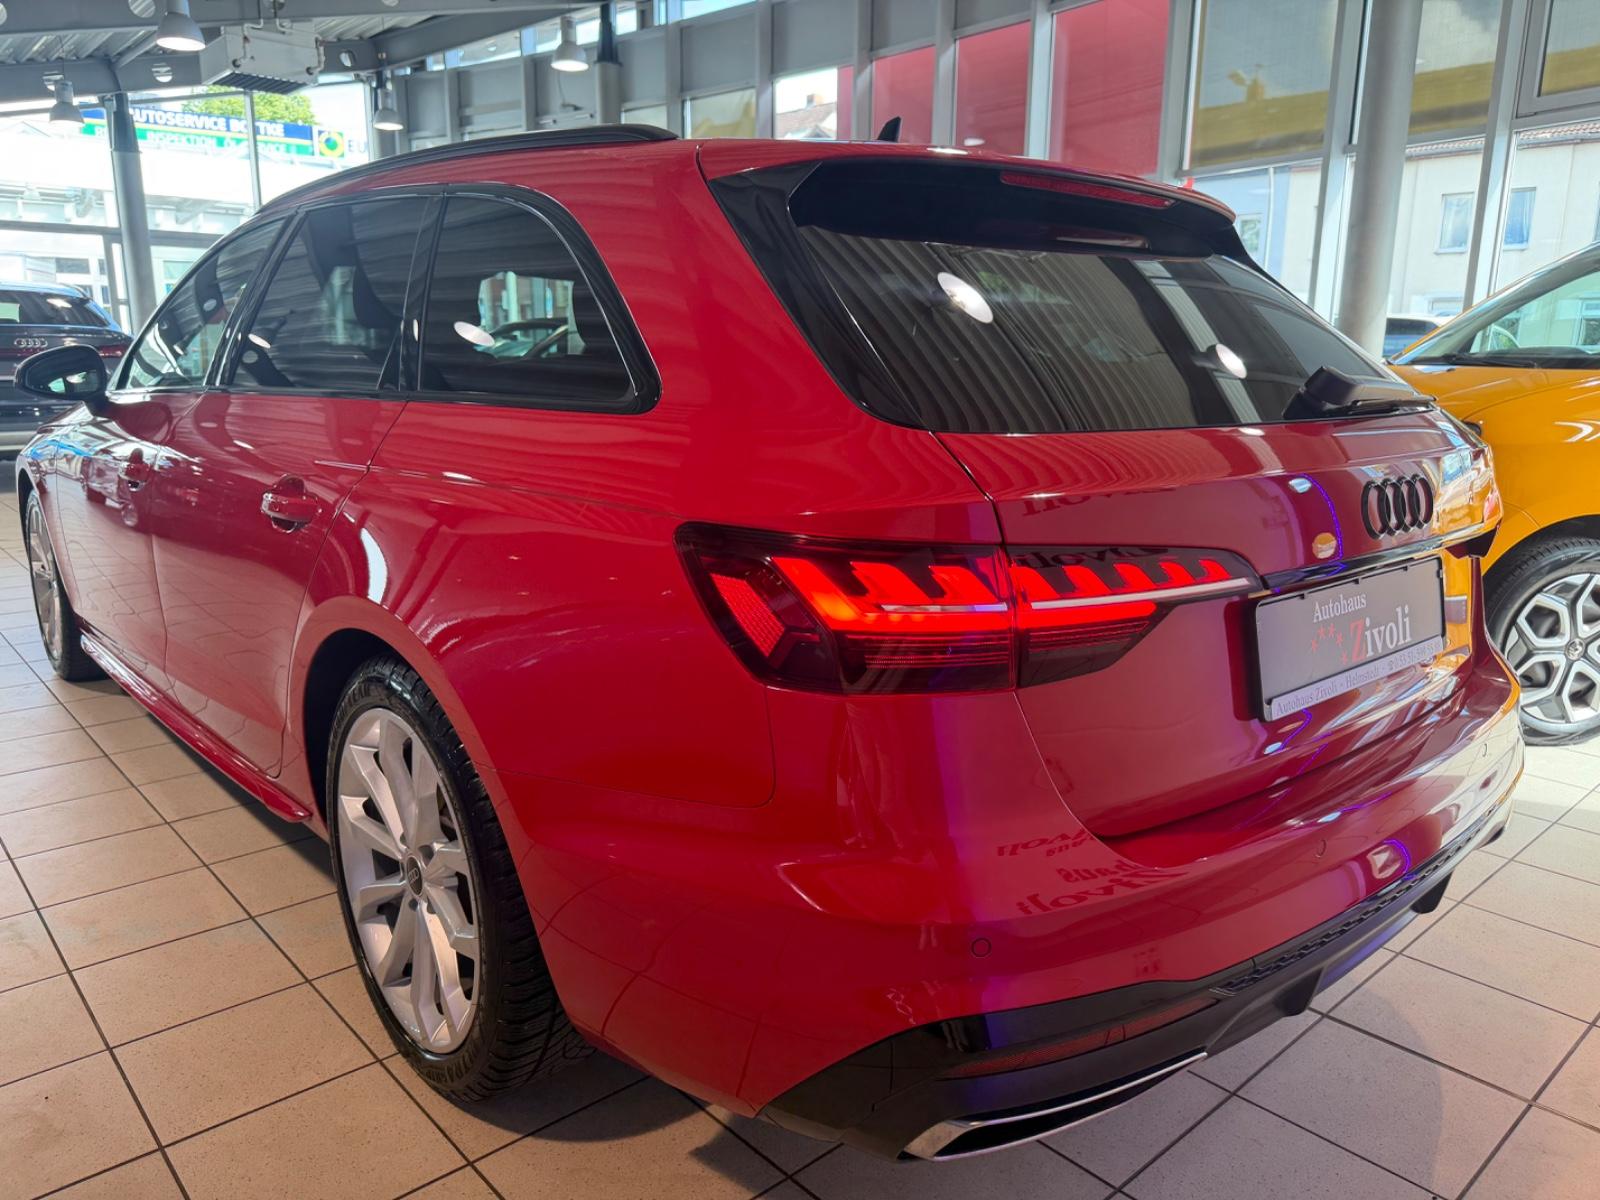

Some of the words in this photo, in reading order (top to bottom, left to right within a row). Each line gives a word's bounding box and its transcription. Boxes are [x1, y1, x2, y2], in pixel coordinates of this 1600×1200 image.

[1313, 593, 1367, 623] Autohaus
[1349, 604, 1412, 663] Zivoli
[1276, 693, 1313, 717] Autohaus
